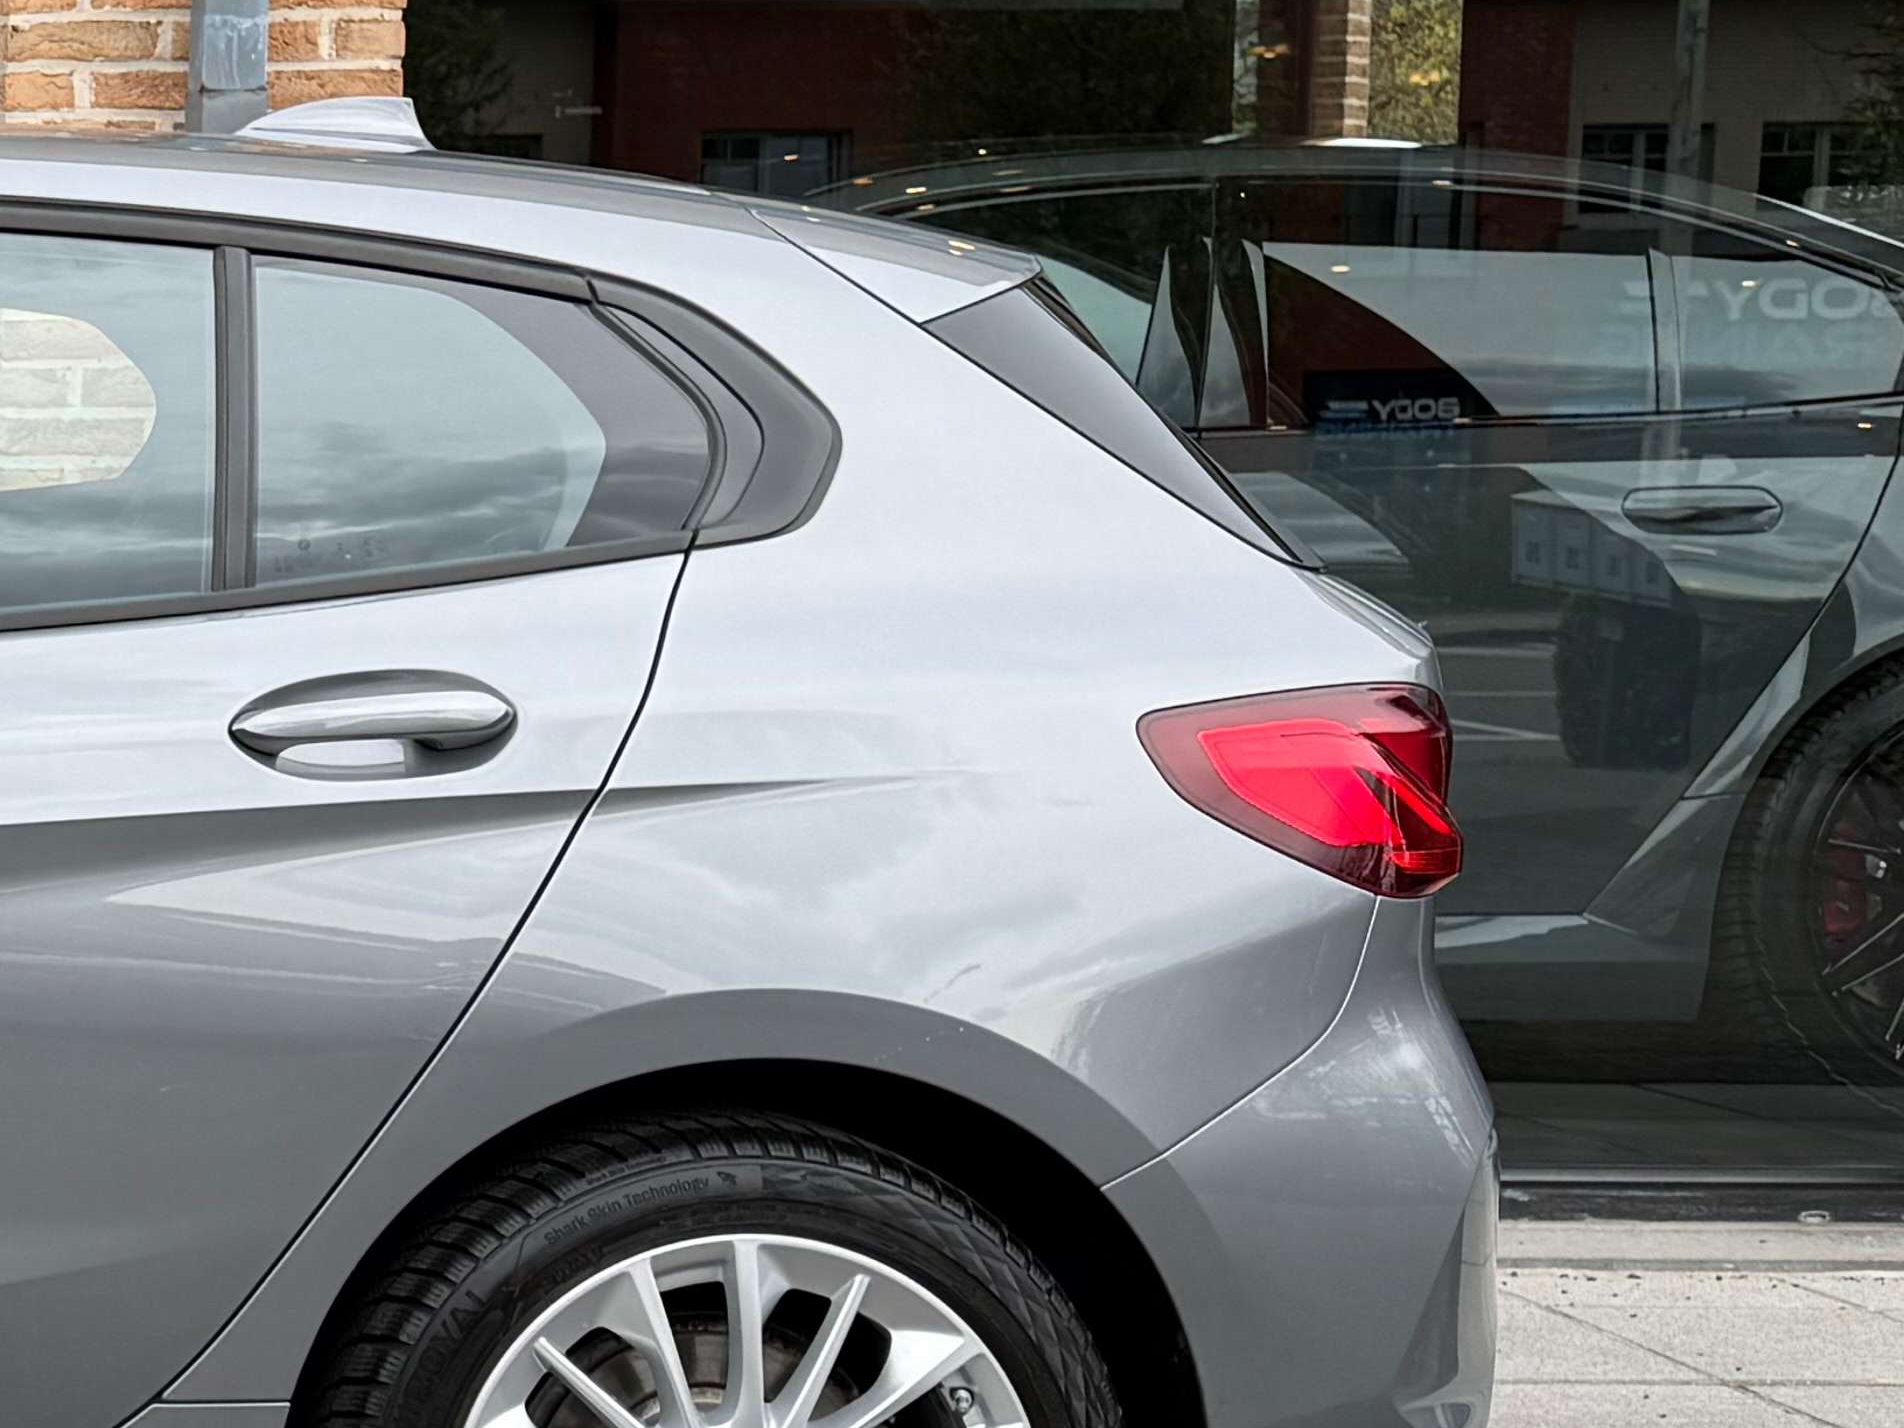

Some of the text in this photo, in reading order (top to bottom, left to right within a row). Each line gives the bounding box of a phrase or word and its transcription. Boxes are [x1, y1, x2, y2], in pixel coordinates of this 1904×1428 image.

[543, 1176, 709, 1245] Shark Skin Technology
